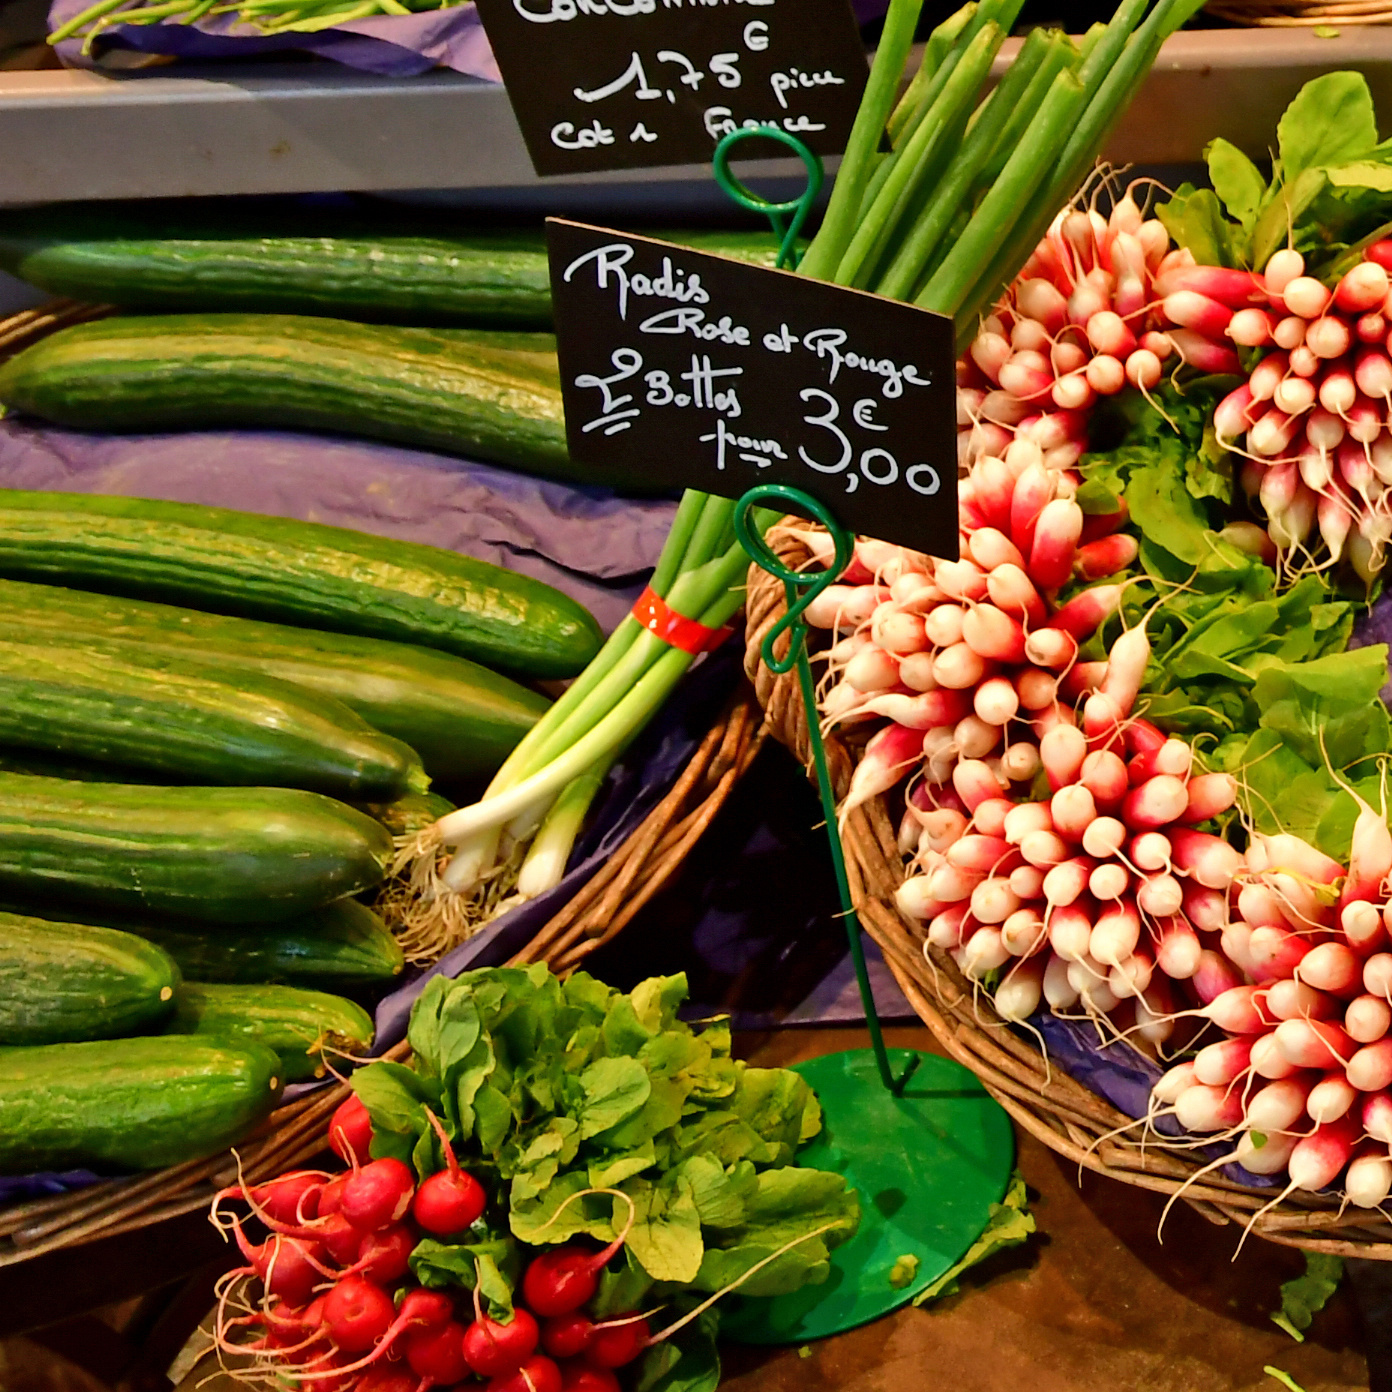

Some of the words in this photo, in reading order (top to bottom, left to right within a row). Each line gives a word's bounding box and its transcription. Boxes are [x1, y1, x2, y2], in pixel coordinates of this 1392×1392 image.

[563, 242, 711, 321] Radis
[638, 307, 752, 347] Rose
[802, 327, 932, 400] Rouge
